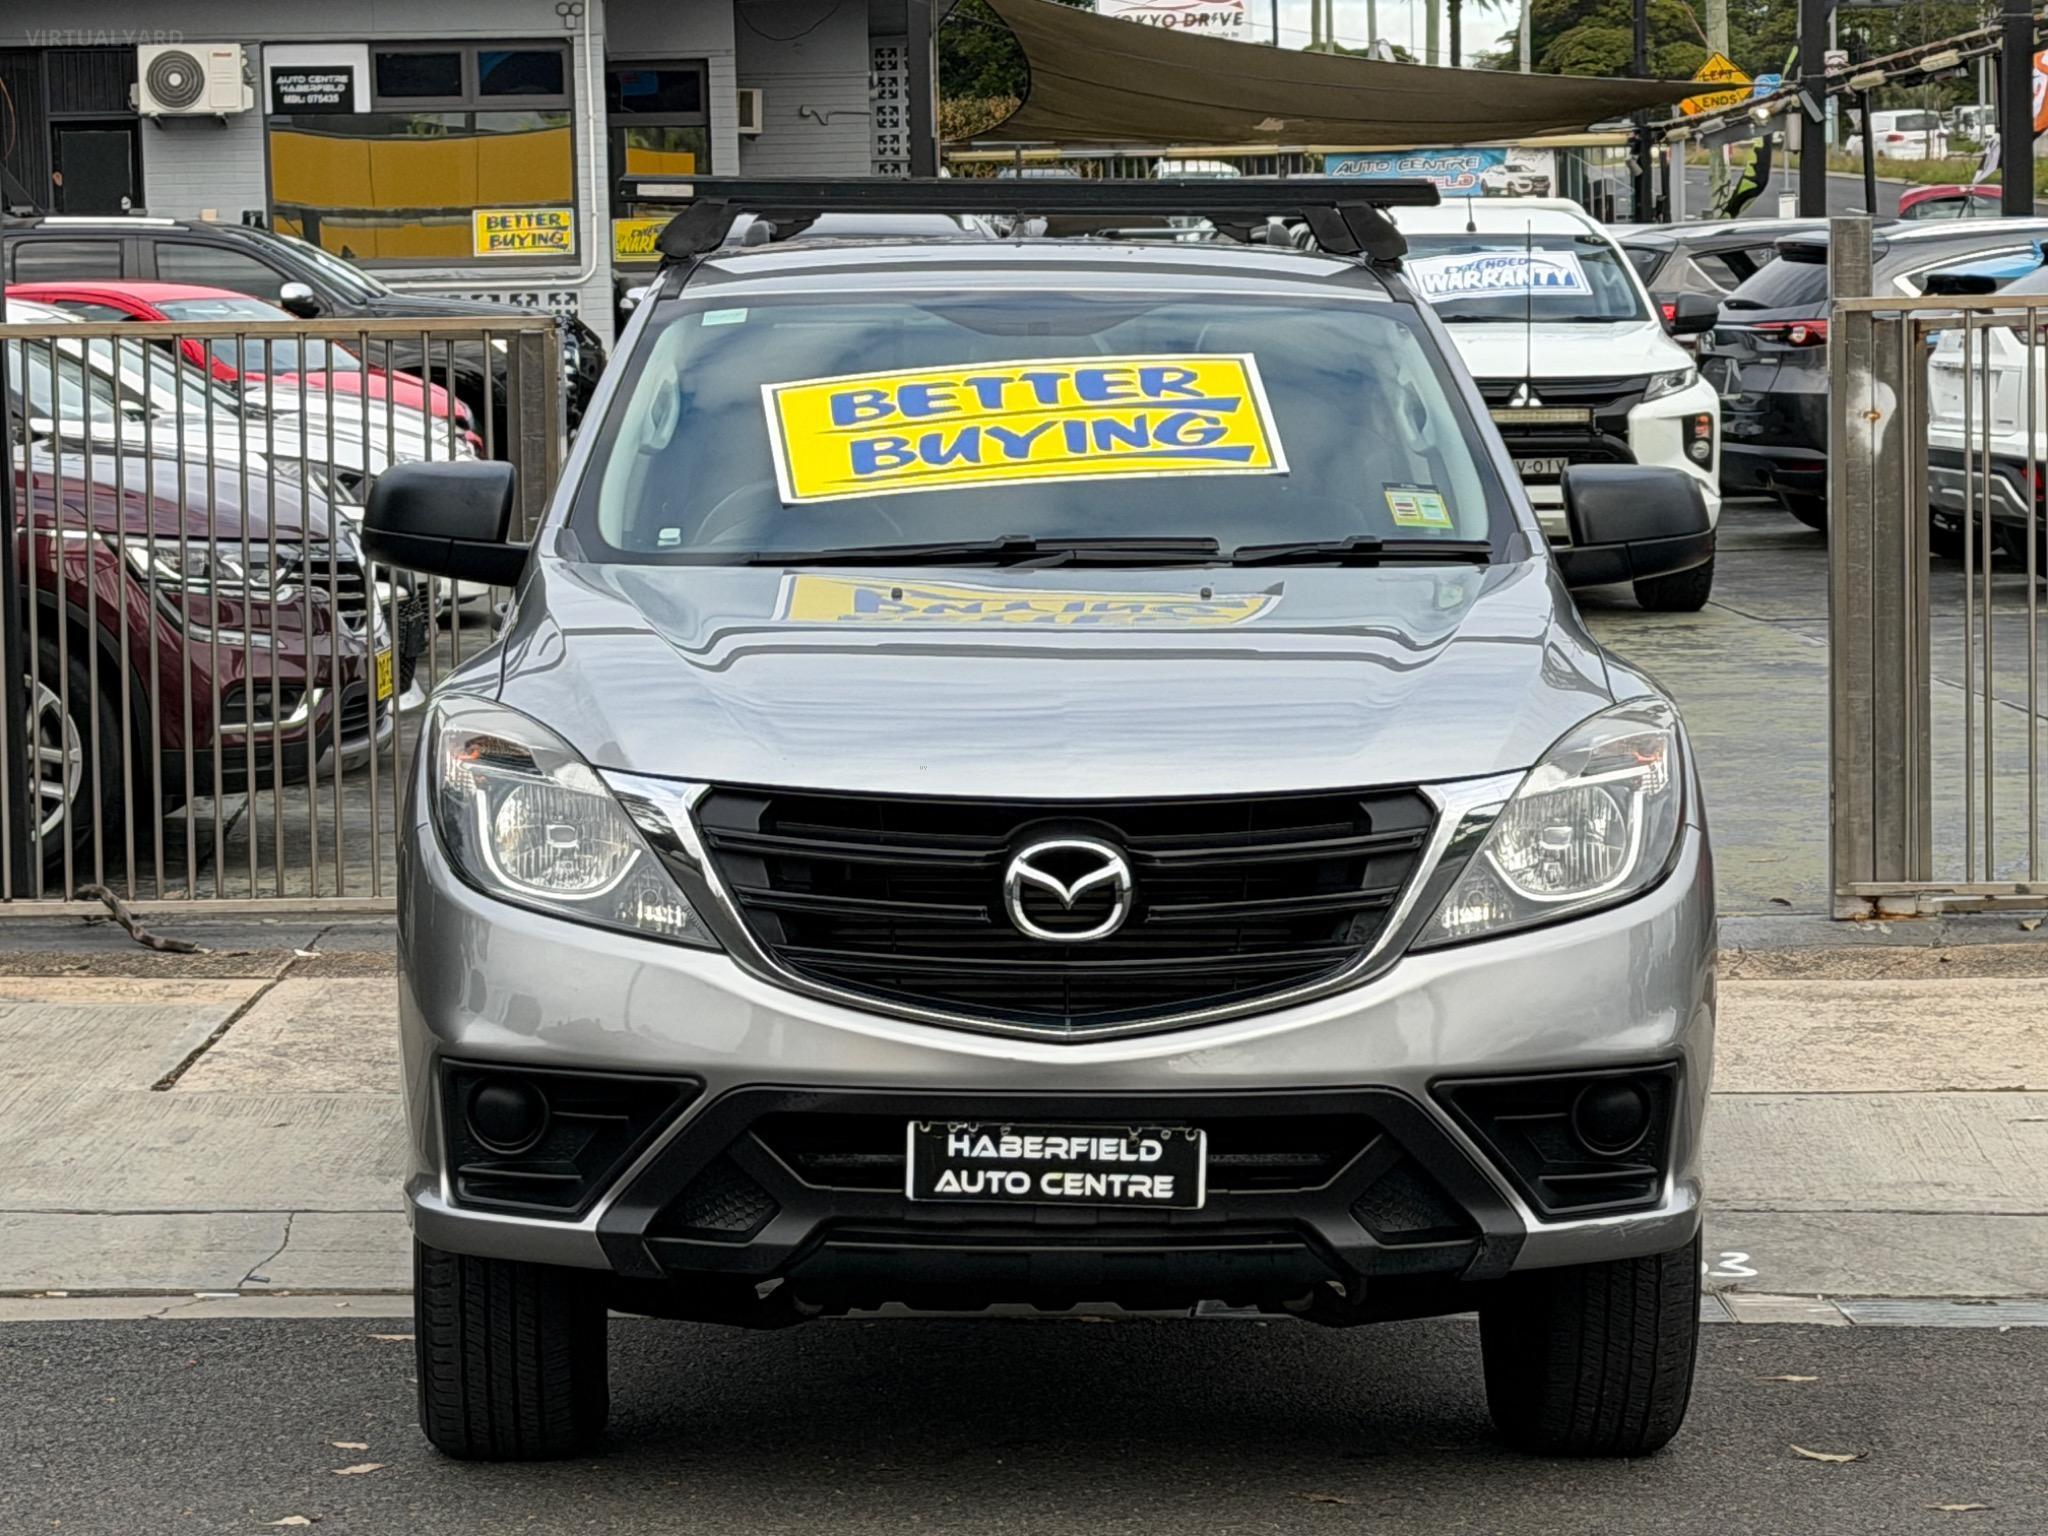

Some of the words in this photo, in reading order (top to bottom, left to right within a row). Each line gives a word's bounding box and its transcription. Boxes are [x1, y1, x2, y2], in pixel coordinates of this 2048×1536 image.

[276, 75, 306, 84] AUTO
[308, 74, 349, 83] CENTRE
[280, 84, 346, 93] HABERFIELD
[1703, 95, 1737, 106] ENDS
[1333, 159, 1391, 176] AUTO
[1397, 156, 1479, 172] CENTRE
[487, 213, 562, 230] BETTER
[489, 231, 564, 248] BUYING
[1444, 257, 1528, 274] EXTENDED
[1423, 268, 1570, 293] WARRANTY
[831, 366, 1205, 427] BETTER
[849, 411, 1230, 476] BUYING
[947, 1134, 1163, 1162] HABERFIELD
[934, 1170, 1031, 1194] AUTO
[1040, 1172, 1175, 1199] CENTRE
